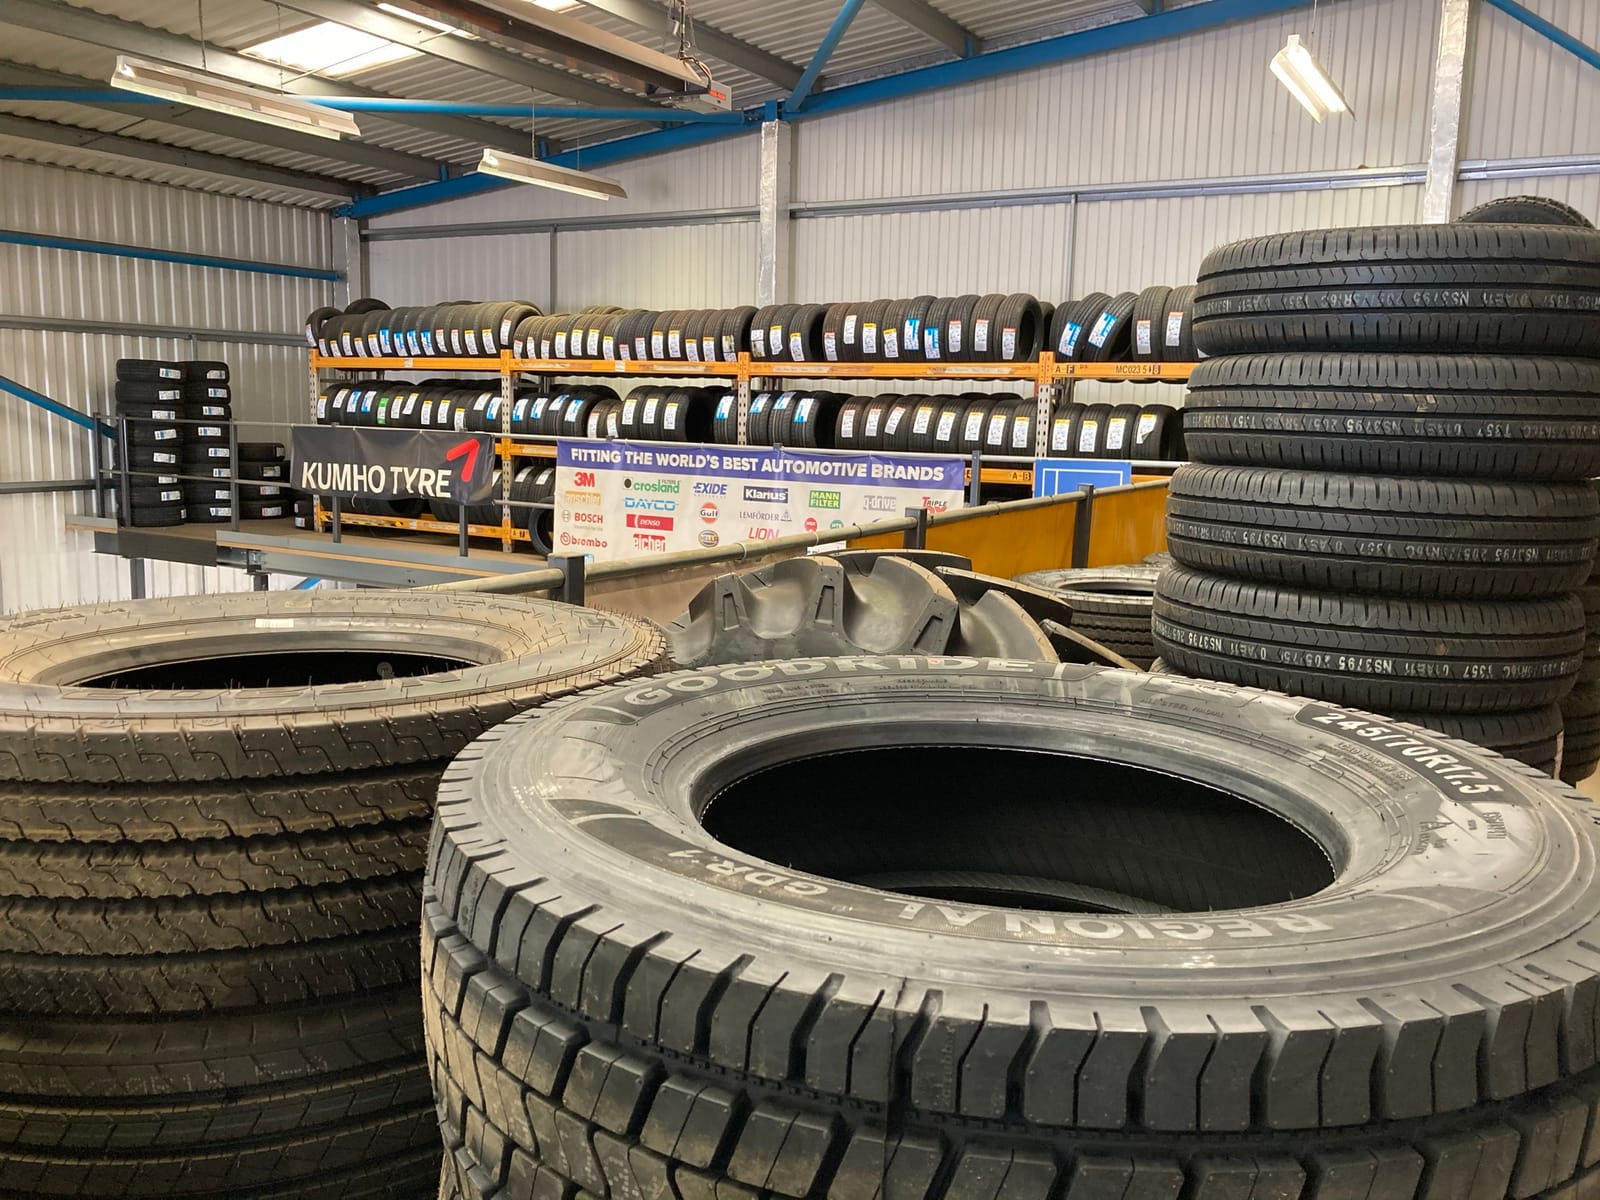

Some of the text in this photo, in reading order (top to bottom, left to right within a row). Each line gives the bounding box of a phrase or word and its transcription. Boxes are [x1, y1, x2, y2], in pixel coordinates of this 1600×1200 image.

[571, 448, 945, 482] FITTING THE WORLD'S BEST AUTOMOTIVE BRANDS
[302, 461, 452, 498] KUMHO TYRE
[574, 471, 595, 488] 3M
[633, 479, 680, 494] crosland
[693, 482, 728, 496] EXIDE
[744, 488, 787, 501] Klarius
[810, 491, 840, 501] MANN
[624, 497, 676, 512] DAYCO
[809, 499, 840, 509] FILTER
[573, 511, 604, 525] BOSCH
[700, 508, 719, 518] Gulf
[639, 518, 662, 528] DENSO
[748, 526, 781, 541] LION
[1338, 655, 1393, 675] NS3795
[623, 656, 1035, 706] GOODRIDE
[1311, 712, 1505, 795] 245/70R17.5
[883, 898, 1334, 941] REGIONAL
